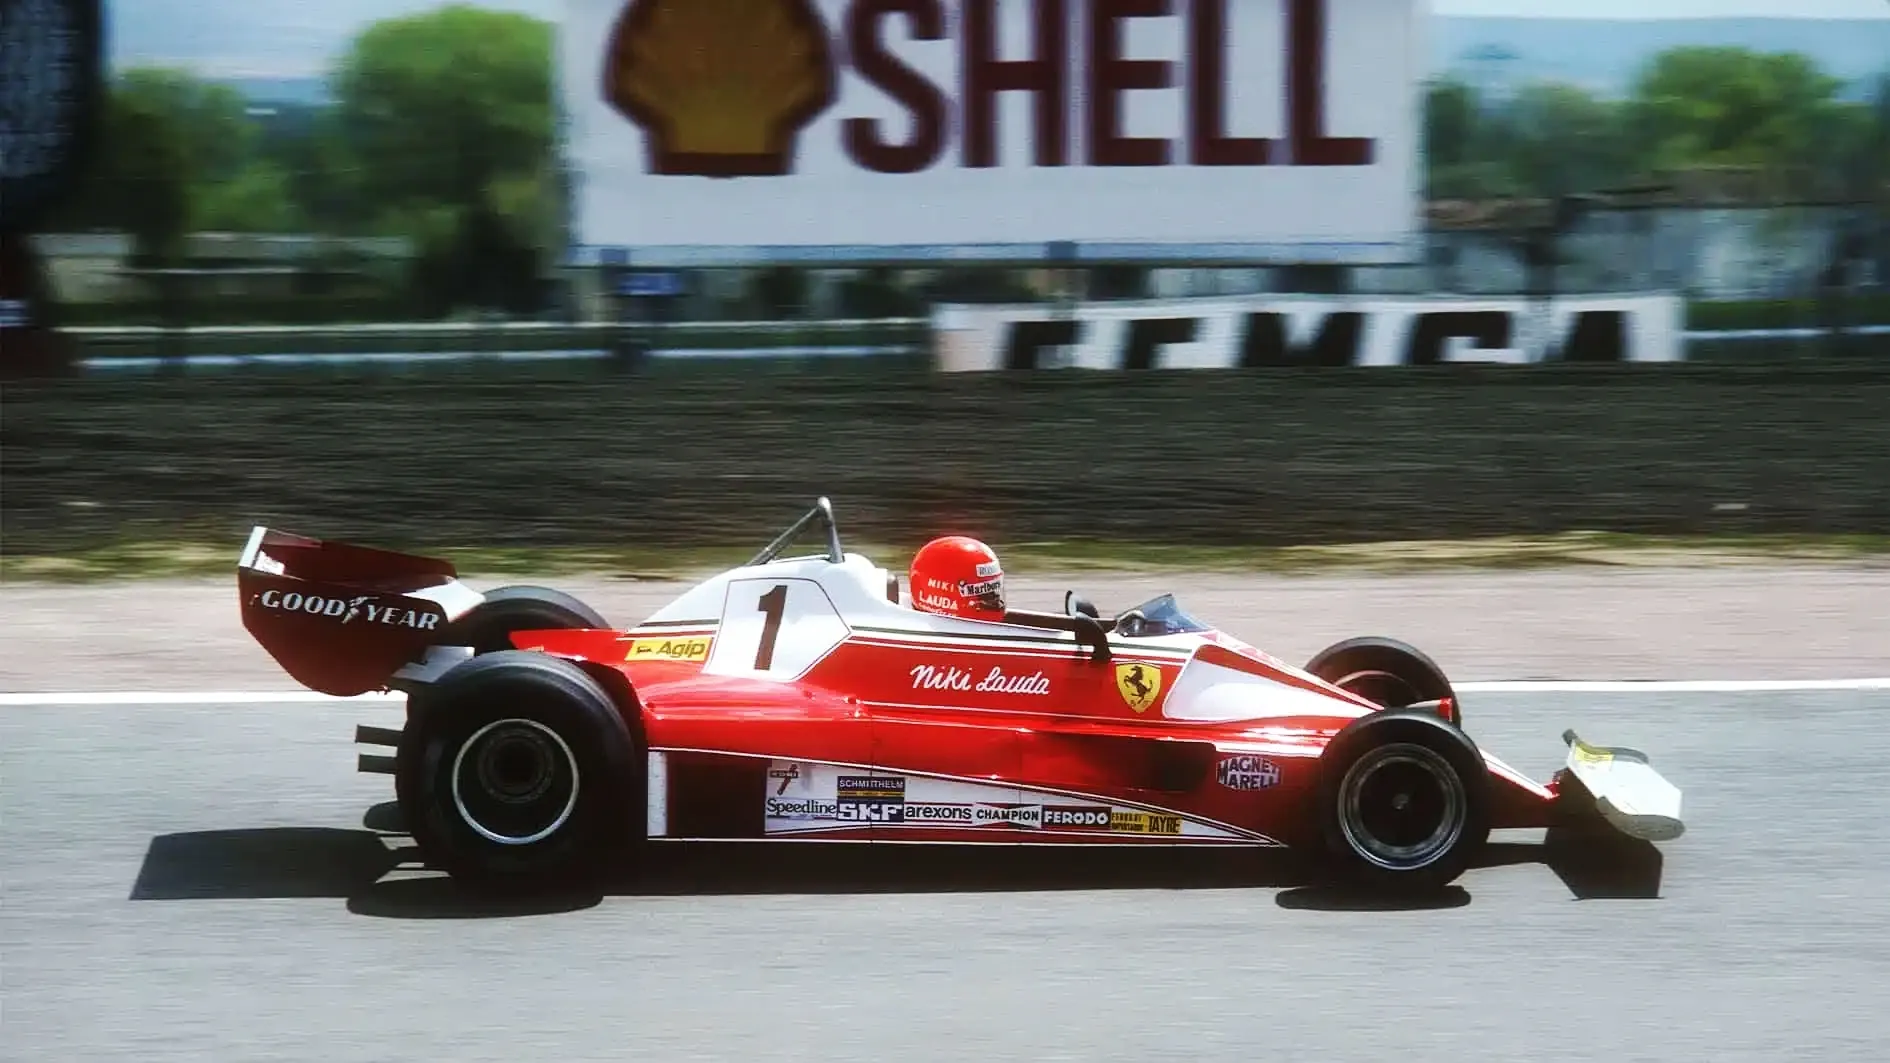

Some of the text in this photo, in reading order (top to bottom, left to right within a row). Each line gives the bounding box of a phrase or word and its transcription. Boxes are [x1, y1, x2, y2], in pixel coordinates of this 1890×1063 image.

[842, 0, 1375, 173] SHELL
[927, 578, 955, 593] NIKI
[919, 590, 959, 611] LAUDA
[754, 585, 788, 670] 1
[656, 640, 706, 658] Agip
[910, 664, 1050, 695] Niki Lauda
[767, 797, 838, 814] Speedline
[838, 802, 903, 821] SKF
[905, 805, 972, 819] arexons
[976, 809, 1039, 821] CHAMPION
[1044, 810, 1108, 825] FERODO
